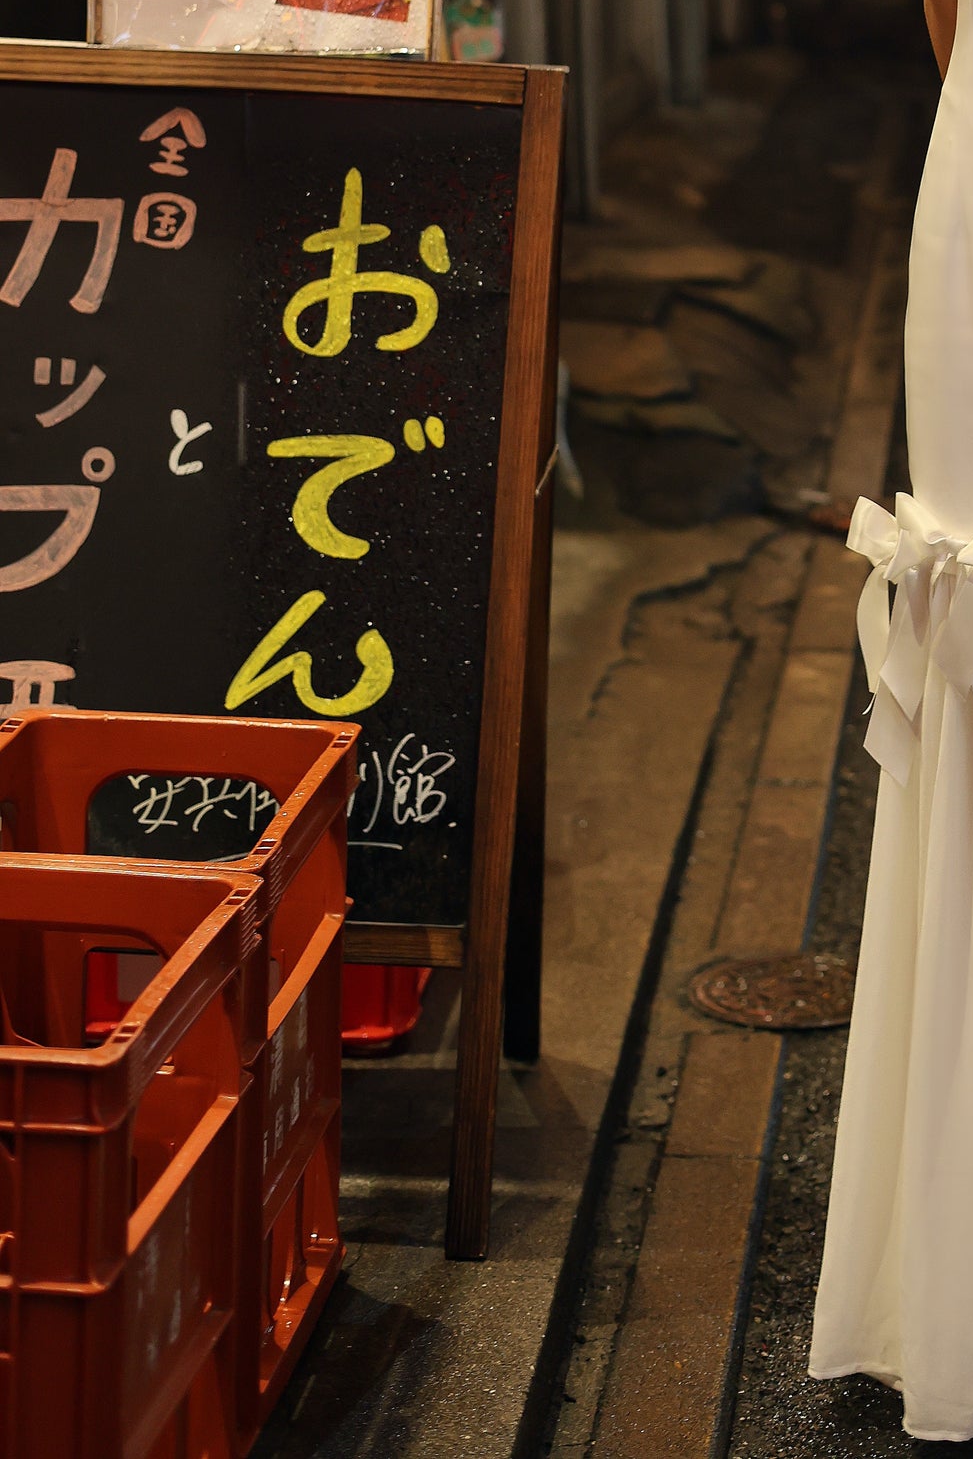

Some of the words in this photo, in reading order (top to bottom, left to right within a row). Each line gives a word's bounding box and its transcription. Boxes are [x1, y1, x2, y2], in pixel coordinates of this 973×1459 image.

[132, 106, 207, 251] 全国
[166, 408, 213, 476] と
[224, 167, 452, 718] おでん
